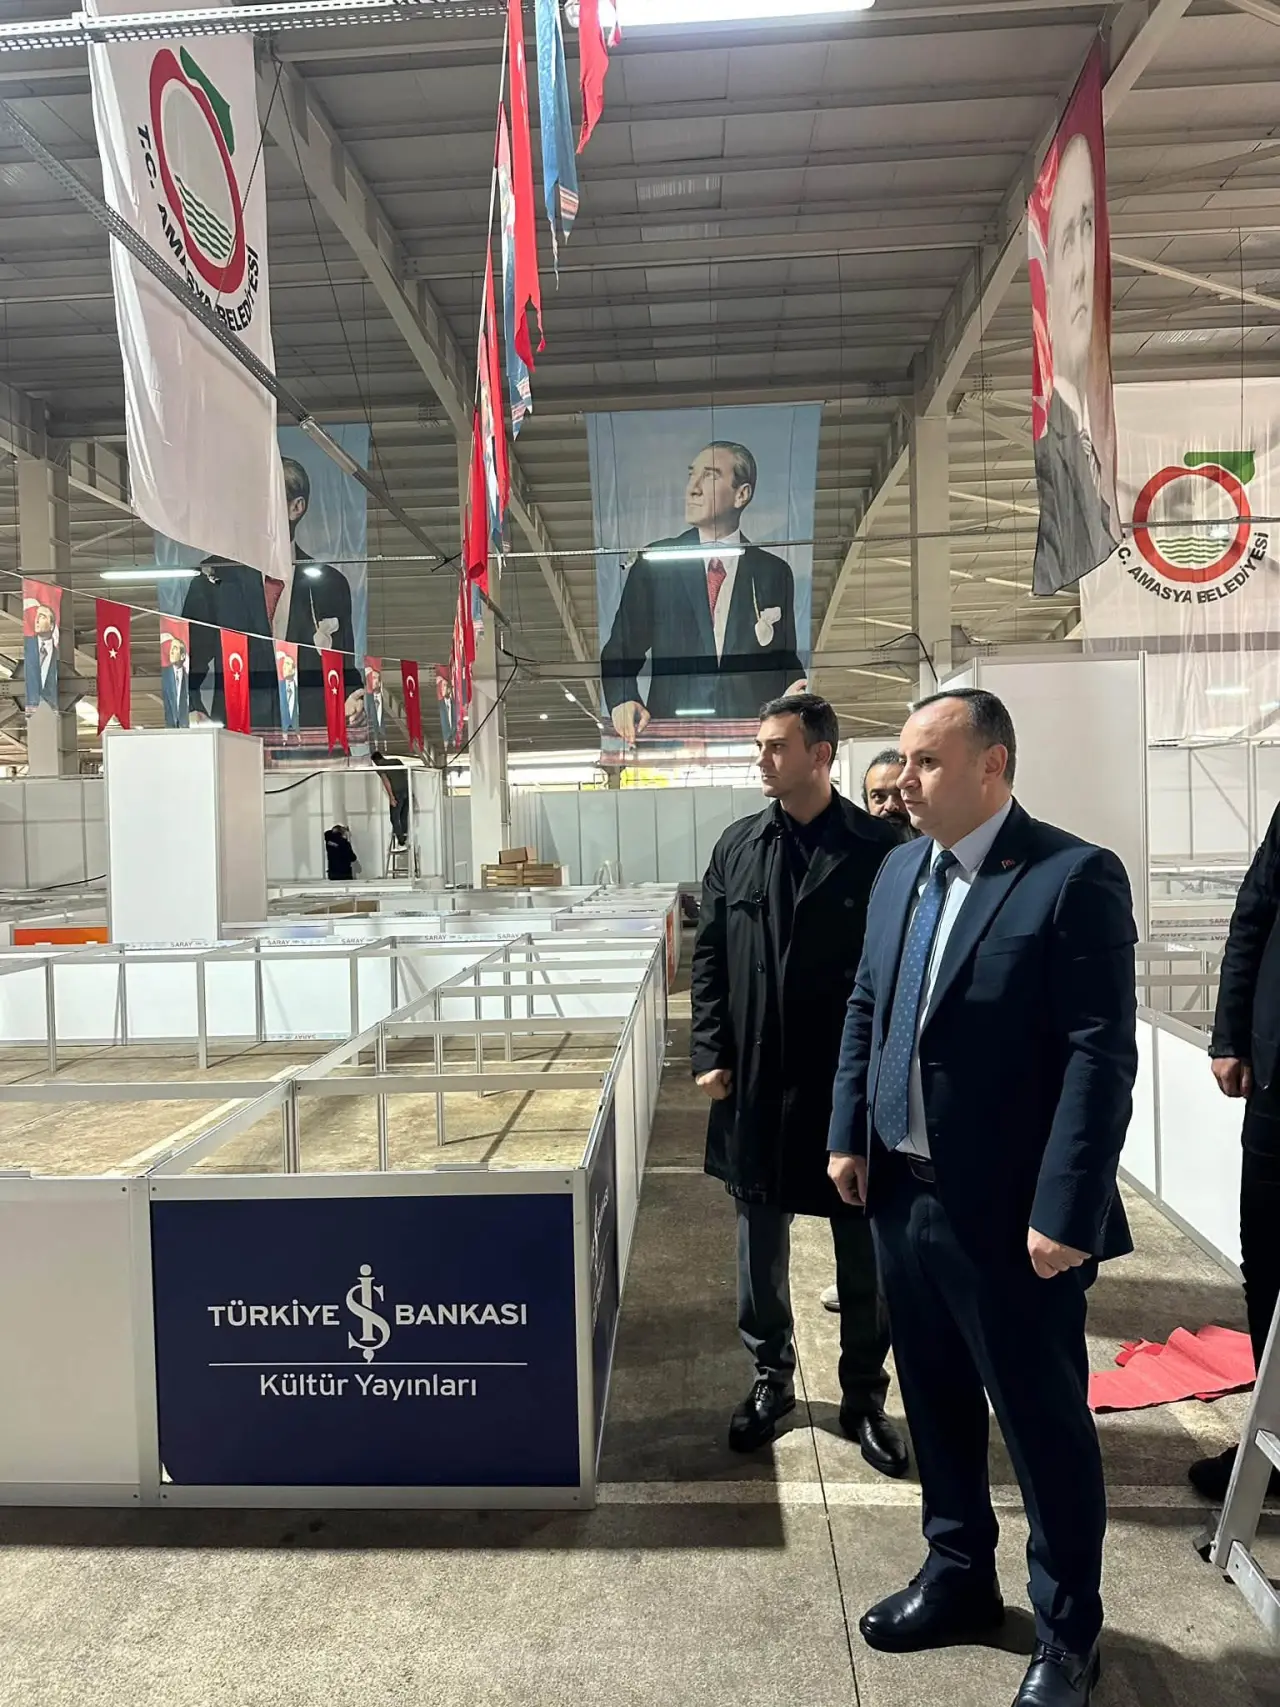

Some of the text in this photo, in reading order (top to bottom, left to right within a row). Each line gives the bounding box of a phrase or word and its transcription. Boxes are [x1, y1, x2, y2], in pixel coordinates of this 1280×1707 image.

[137, 124, 157, 189] T.C.
[1127, 566, 1192, 603] AMASYA
[1196, 532, 1269, 603] BELEDİYESİ
[207, 1299, 341, 1327] TÜRKİYE
[394, 1303, 528, 1326] BANKASI
[260, 1373, 478, 1401] Kültür Yayınları
